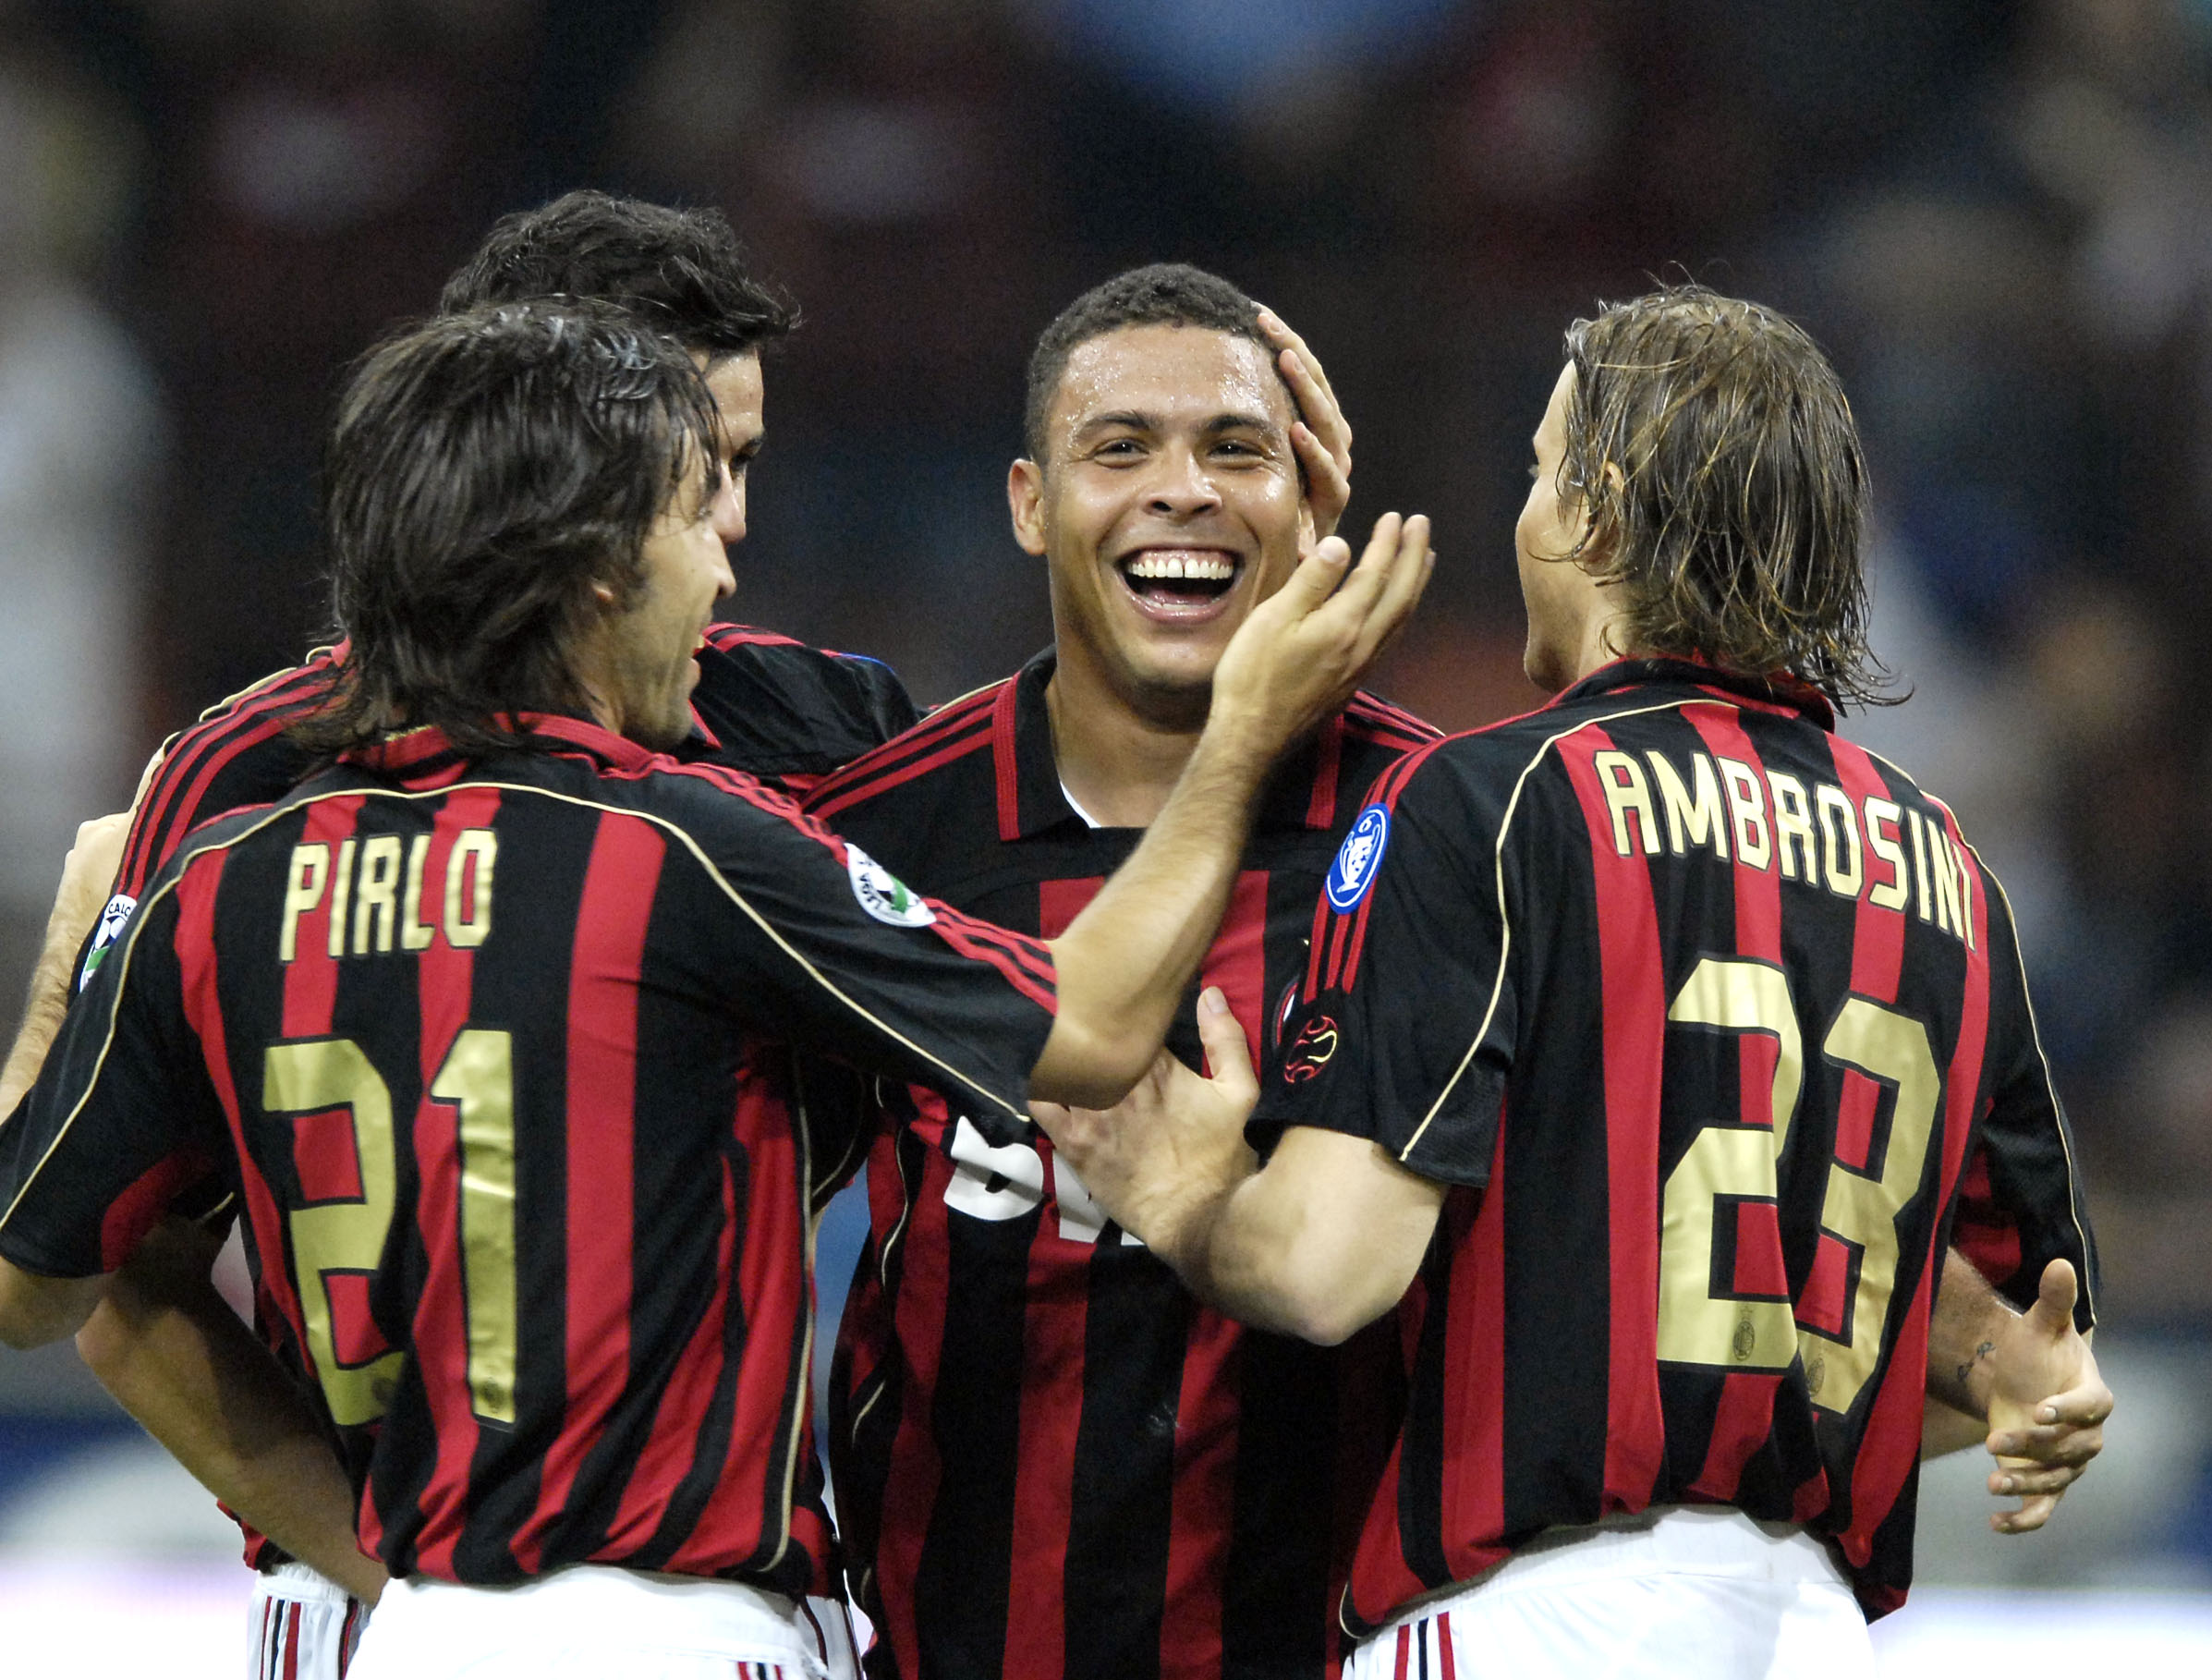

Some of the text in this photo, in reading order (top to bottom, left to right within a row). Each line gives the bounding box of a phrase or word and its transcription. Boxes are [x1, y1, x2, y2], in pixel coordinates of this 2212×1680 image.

[279, 828, 498, 962] PIRLO
[1358, 813, 1376, 834] 6
[1595, 749, 1975, 951] AMBROSINI
[262, 1029, 517, 1426] 21
[1657, 958, 1941, 1415] 23
